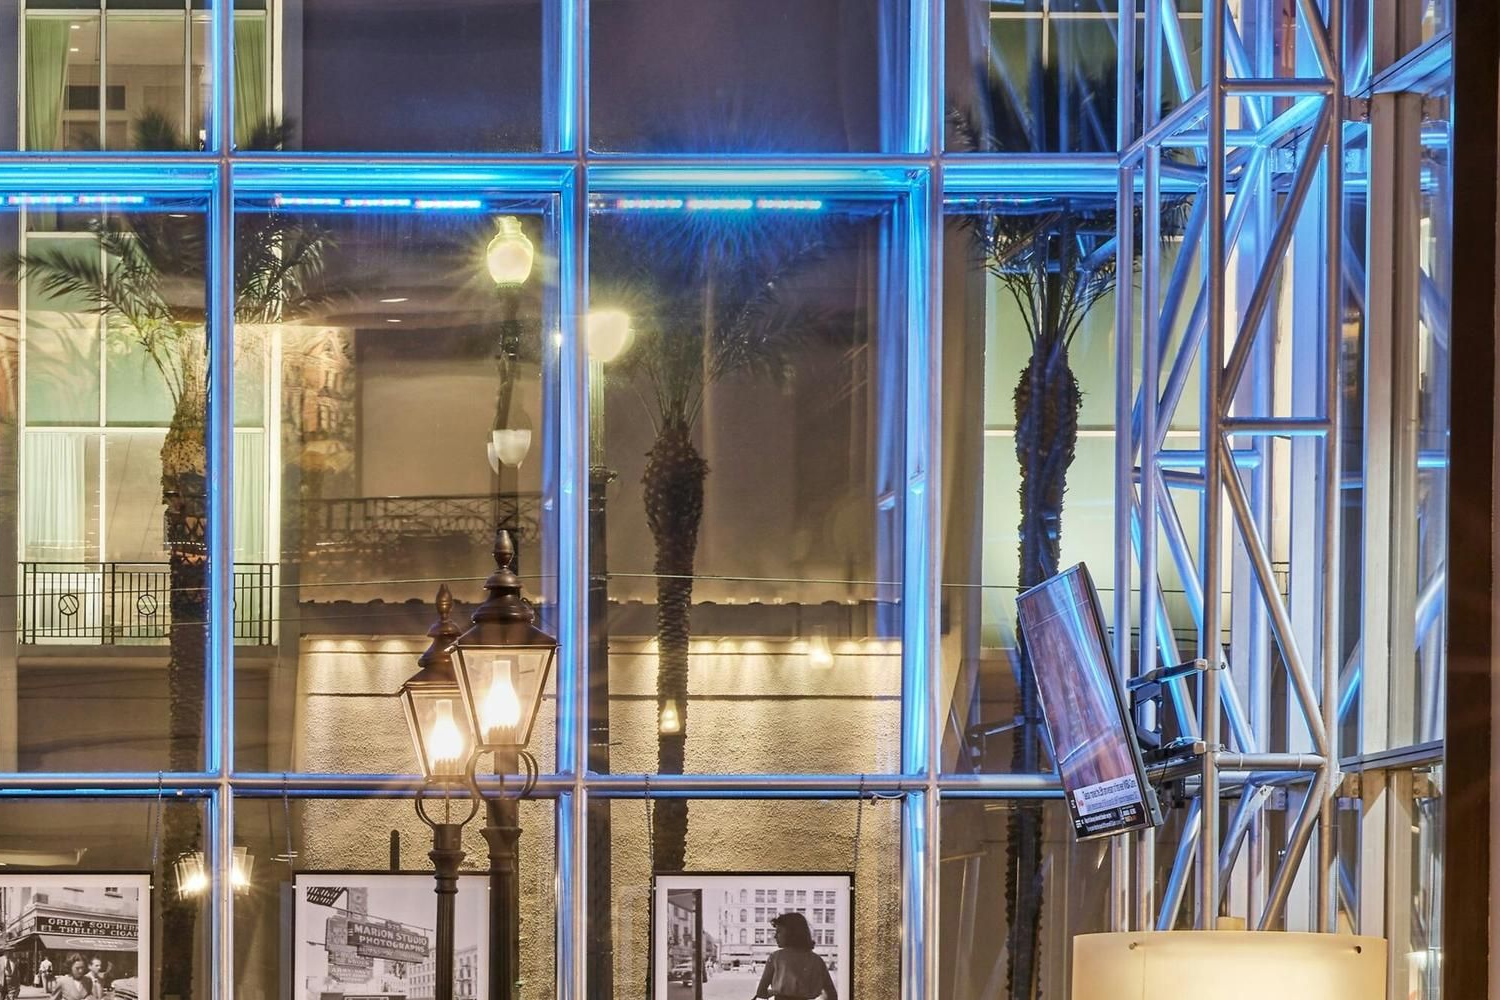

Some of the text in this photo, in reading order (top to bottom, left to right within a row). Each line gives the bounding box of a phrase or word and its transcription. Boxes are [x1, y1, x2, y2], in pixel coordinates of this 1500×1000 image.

[40, 924, 54, 932] EL
[59, 926, 105, 935] TRELLES
[48, 918, 84, 927] GREAT
[354, 923, 394, 940] MARION
[395, 932, 427, 946] STUDIO
[359, 935, 425, 953] PHOTOGRAPHS
